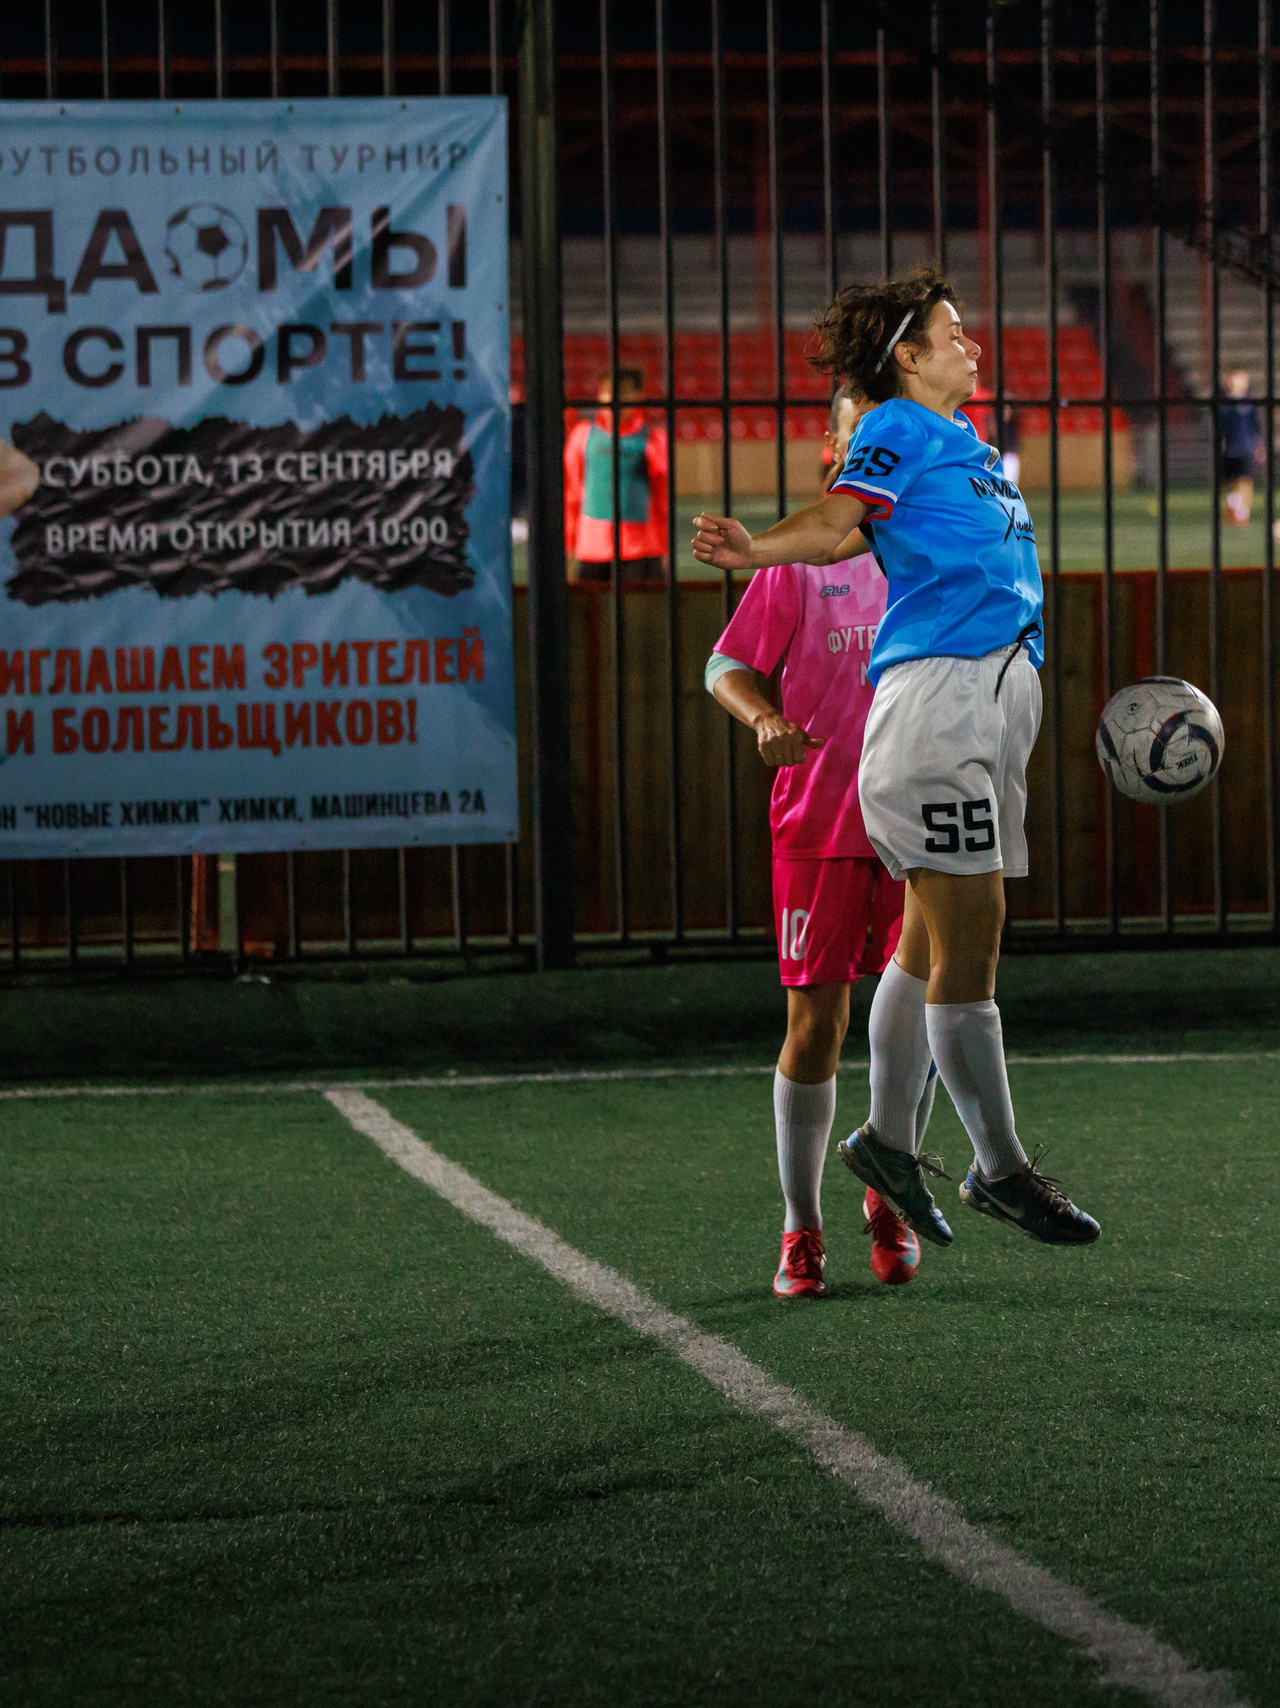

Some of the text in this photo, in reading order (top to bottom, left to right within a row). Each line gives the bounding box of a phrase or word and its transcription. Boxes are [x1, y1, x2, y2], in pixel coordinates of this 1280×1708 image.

[0, 140, 467, 177] УТБОЛЬНЫЙ ТУРНИР
[62, 320, 467, 388] СПОРТЕ!
[44, 448, 454, 487] СУББОТА, 13 СЕНТЯБРЯ
[46, 516, 448, 554] ВРЕМЯ ОТКРЫТИЯ 10:00
[262, 627, 484, 688] ЗРИТЕЛЕЙ
[7, 699, 417, 756] И БОЛЕЛЬЩИКОВ!
[310, 790, 450, 819] МАШИНЦЕВА
[459, 788, 486, 814] 2А
[922, 798, 995, 853] 55
[782, 908, 810, 961] 10
